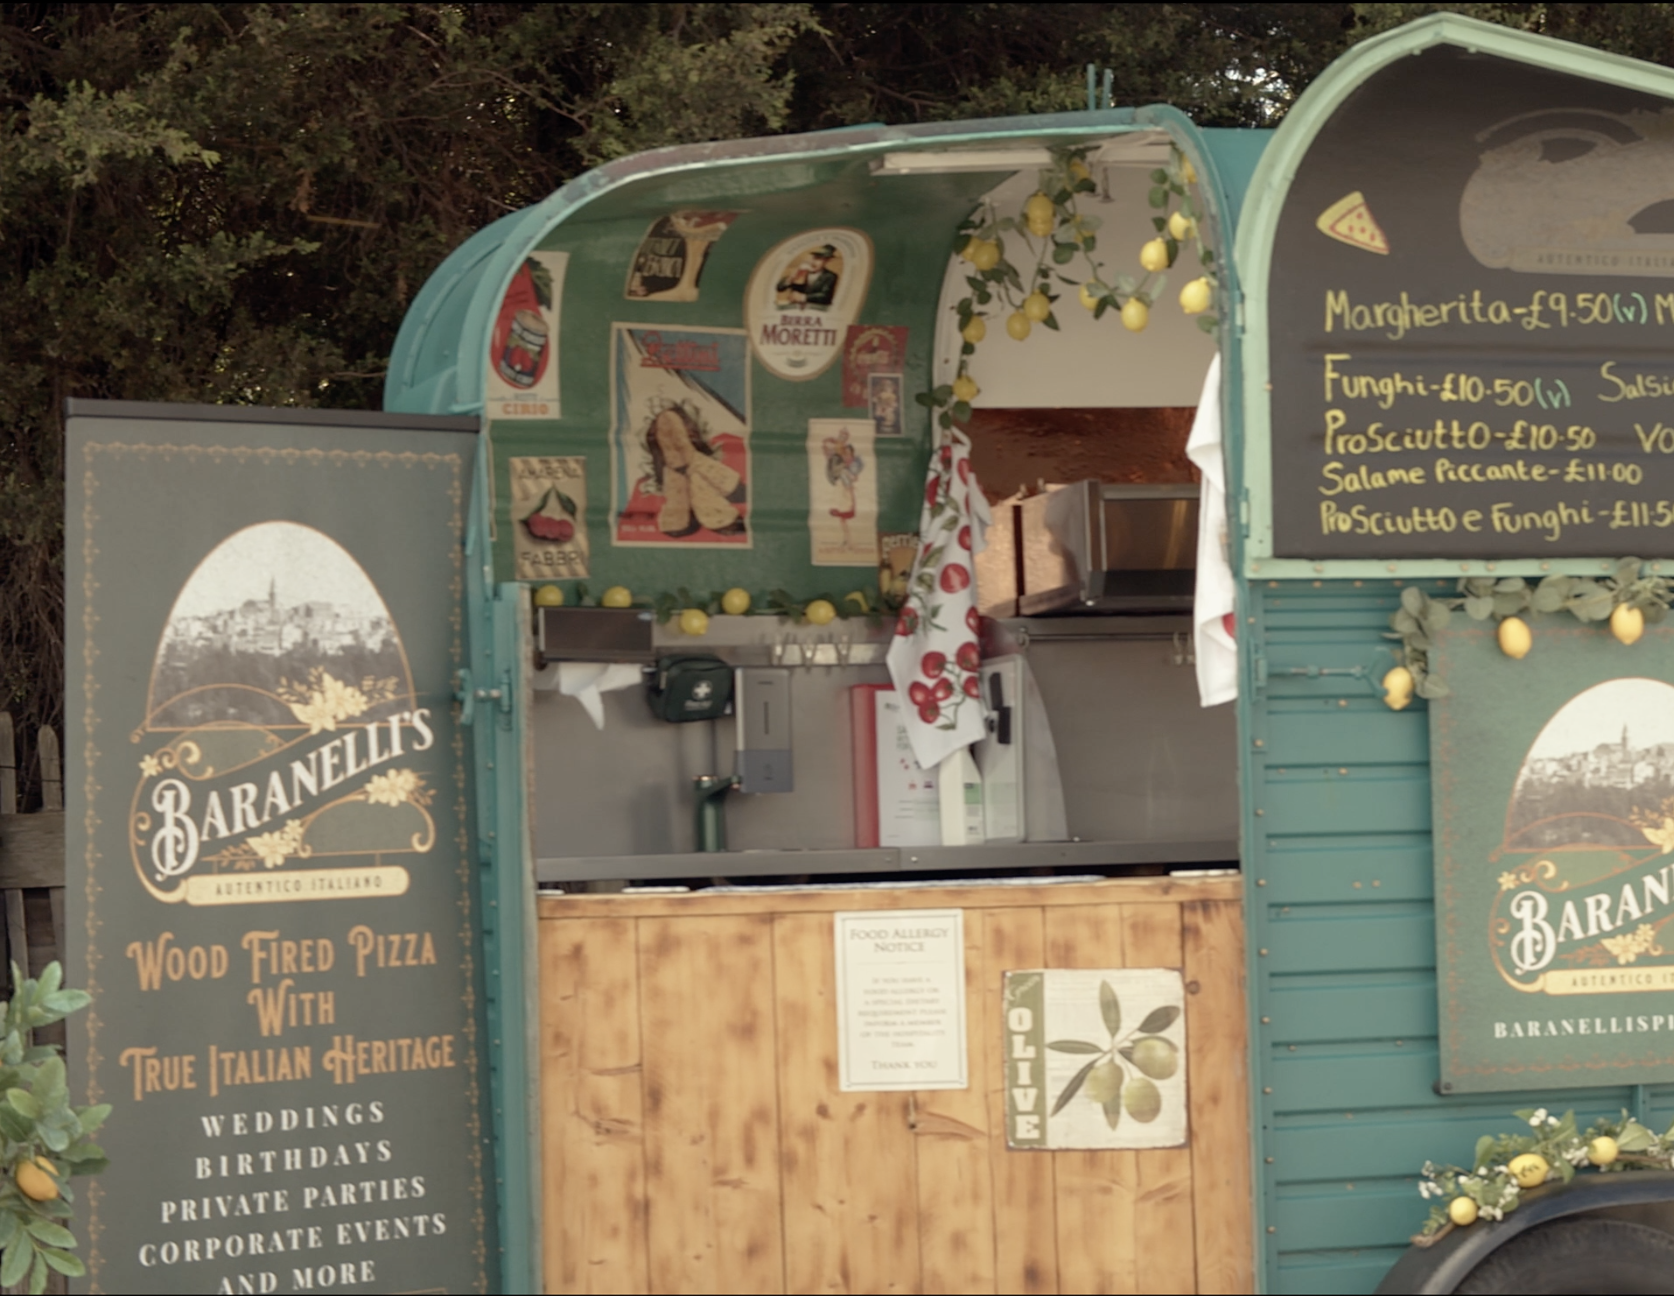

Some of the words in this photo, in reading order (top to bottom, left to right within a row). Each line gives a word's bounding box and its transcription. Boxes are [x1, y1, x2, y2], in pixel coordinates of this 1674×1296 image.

[760, 325, 838, 346] MORETTI
[780, 315, 822, 326] BIRRA
[1317, 459, 1426, 496] Salame
[1462, 508, 1483, 532] e
[151, 708, 434, 880] BARANELLI'S
[215, 879, 303, 896] AUTENTICO
[311, 875, 383, 891] ITALIANO
[850, 929, 888, 940] FOOD
[892, 928, 950, 939] ALLERGY
[874, 942, 925, 953] NOTICE
[125, 932, 229, 991] WOOD
[241, 930, 335, 984] FIRED
[348, 925, 437, 977] PIZZA
[1572, 973, 1654, 988] AUTENTICO
[247, 978, 336, 1036] WITH
[119, 1047, 197, 1101] TRUE
[208, 1044, 312, 1096] ITALIAN
[322, 1035, 456, 1084] HERITAGE
[1008, 1007, 1041, 1139] OLIVE
[201, 1101, 385, 1137] WEDDINGS
[195, 1140, 392, 1180] BIRTHDAYS
[161, 1189, 290, 1224] PRIVATE
[303, 1175, 426, 1209] PARTIES
[139, 1226, 324, 1267] CORPORATE
[337, 1213, 447, 1245] EVENTS
[217, 1271, 278, 1295] AND
[292, 1260, 376, 1290] MORE
